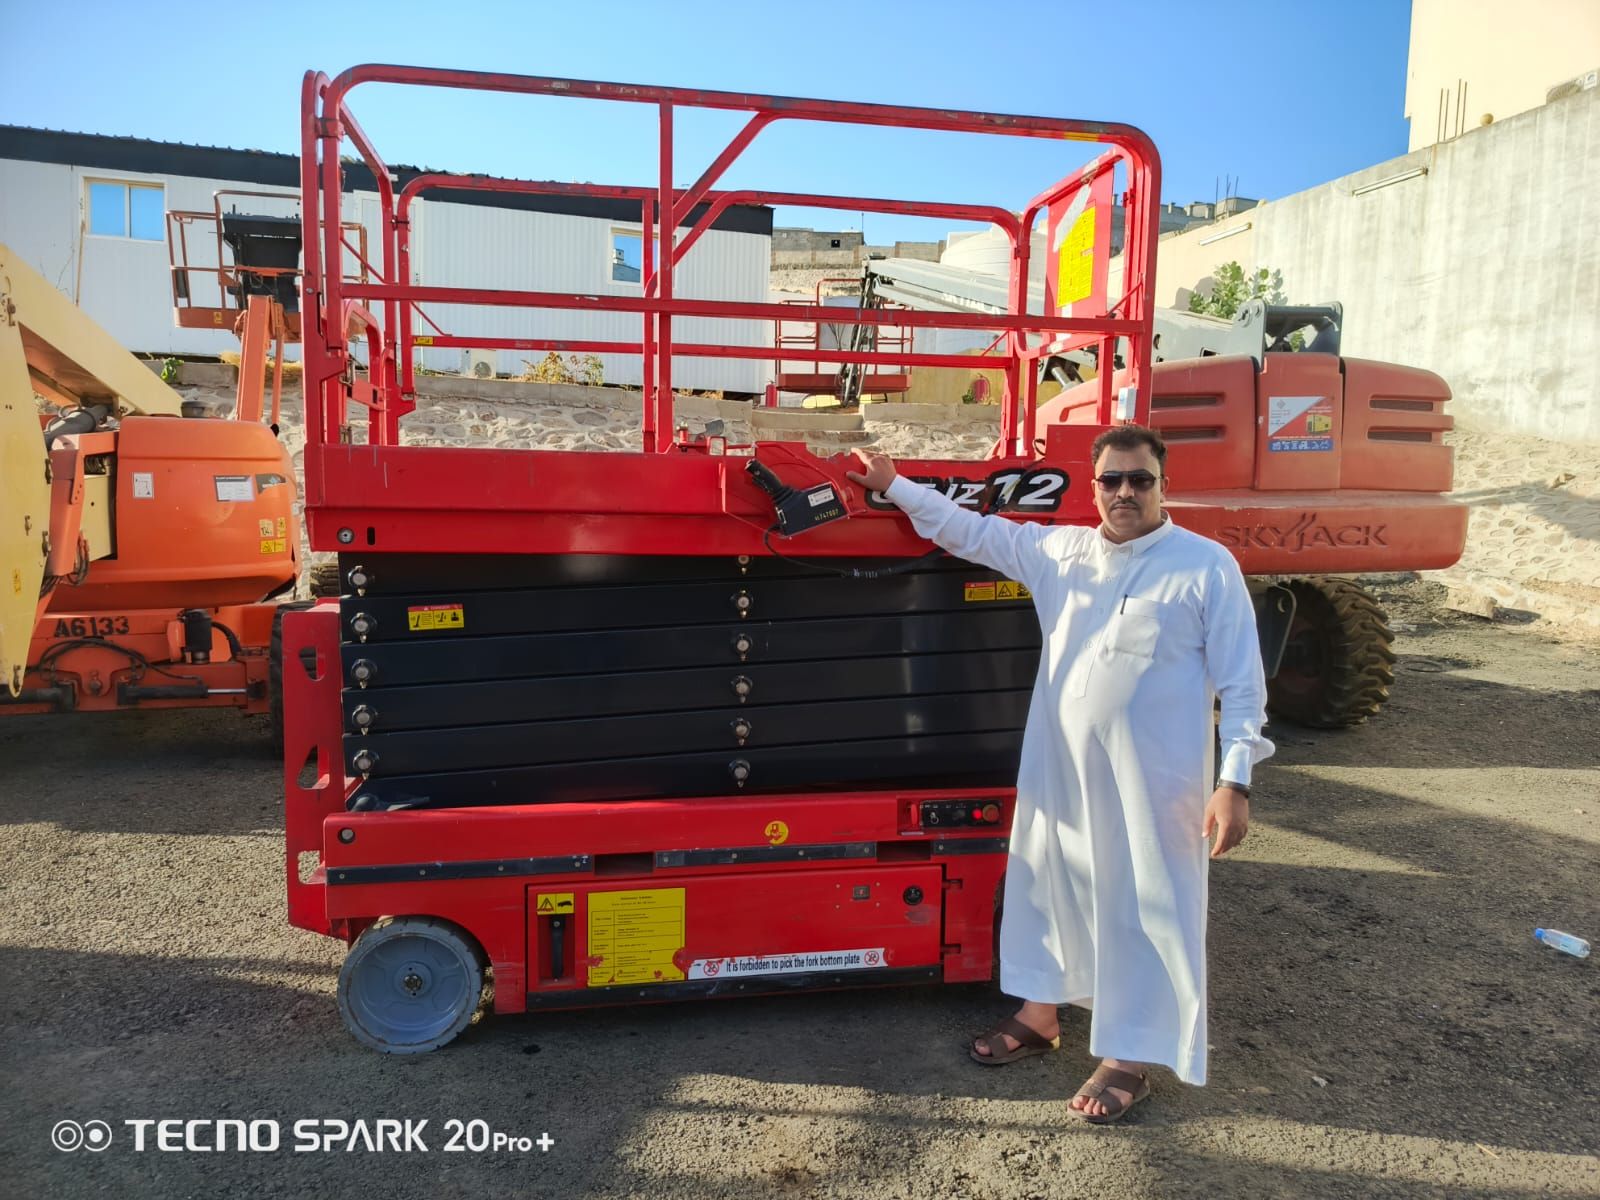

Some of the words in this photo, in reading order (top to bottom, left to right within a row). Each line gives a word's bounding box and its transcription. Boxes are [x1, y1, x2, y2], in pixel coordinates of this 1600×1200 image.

[1217, 512, 1389, 552] SKYJACK
[54, 615, 130, 638] A6133
[726, 960, 732, 972] It
[733, 962, 739, 971] is
[740, 958, 771, 971] forbidden
[771, 960, 779, 969] to
[780, 957, 793, 971] pick
[794, 956, 805, 968] the
[806, 954, 819, 967] fork
[820, 954, 843, 966] bottom
[844, 953, 861, 967] plate
